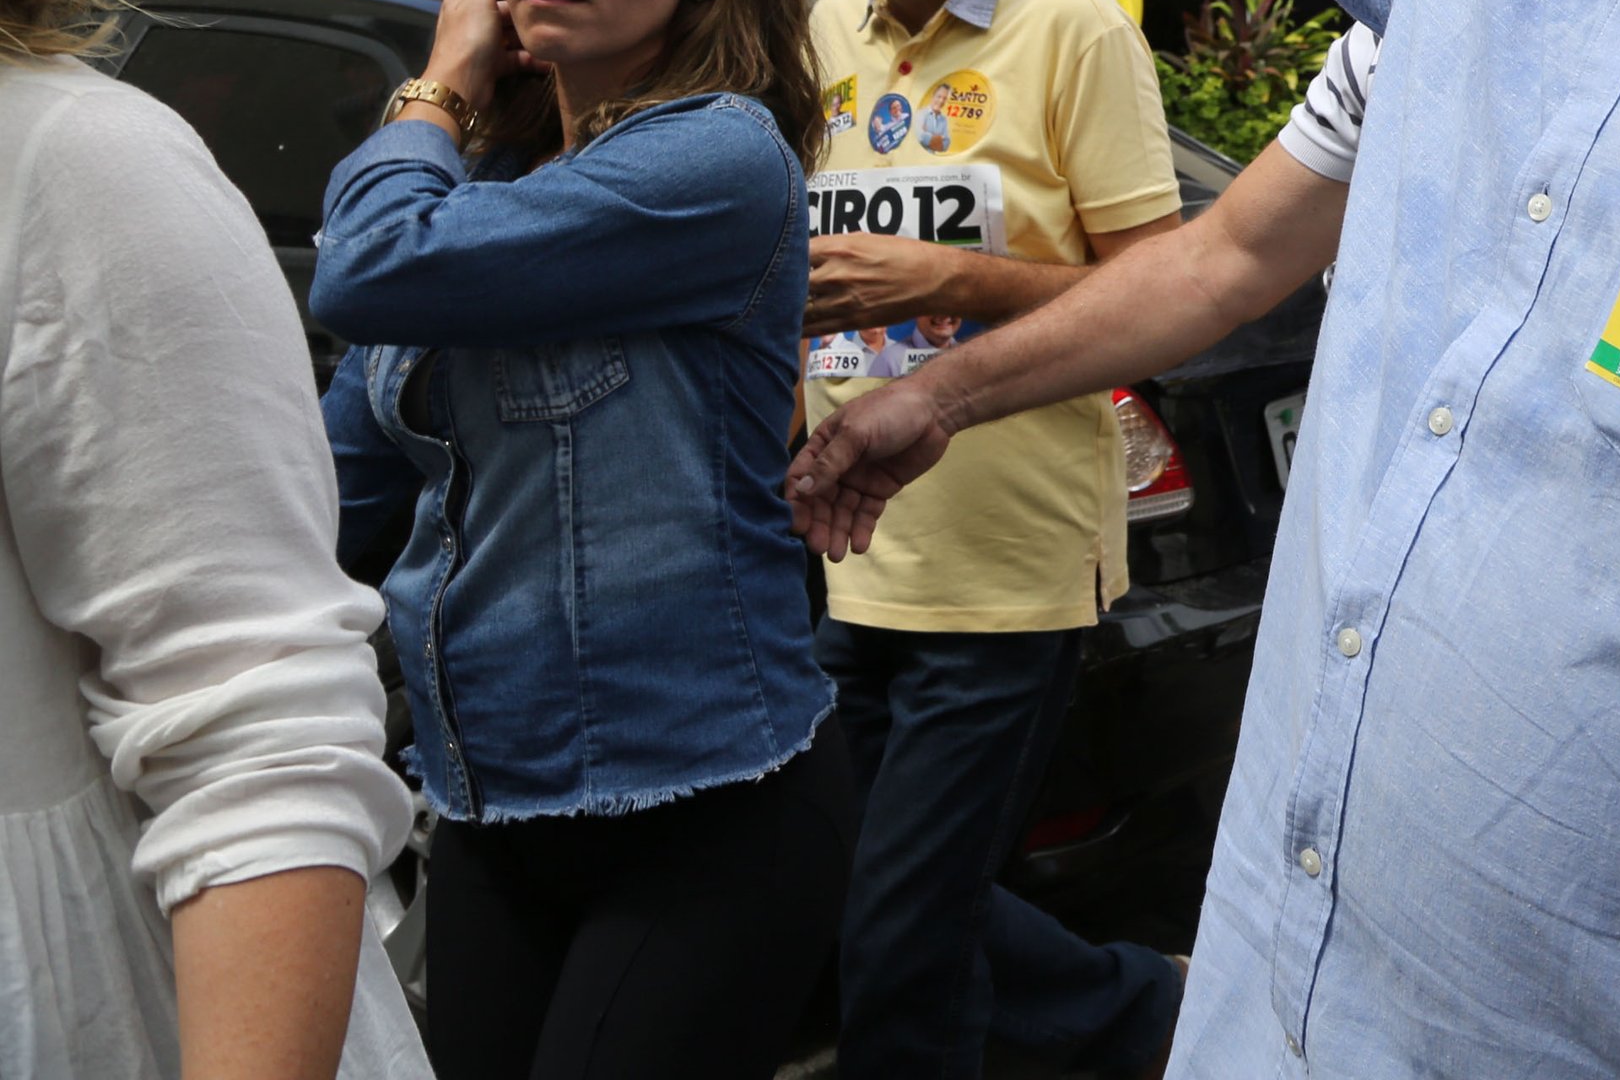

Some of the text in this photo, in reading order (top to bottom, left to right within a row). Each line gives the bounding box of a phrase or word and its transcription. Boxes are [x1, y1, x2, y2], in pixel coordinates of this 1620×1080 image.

[947, 105, 983, 120] 12789
[807, 172, 857, 189] ESIDENTE
[913, 185, 982, 241] 12
[822, 356, 859, 370] 12789
